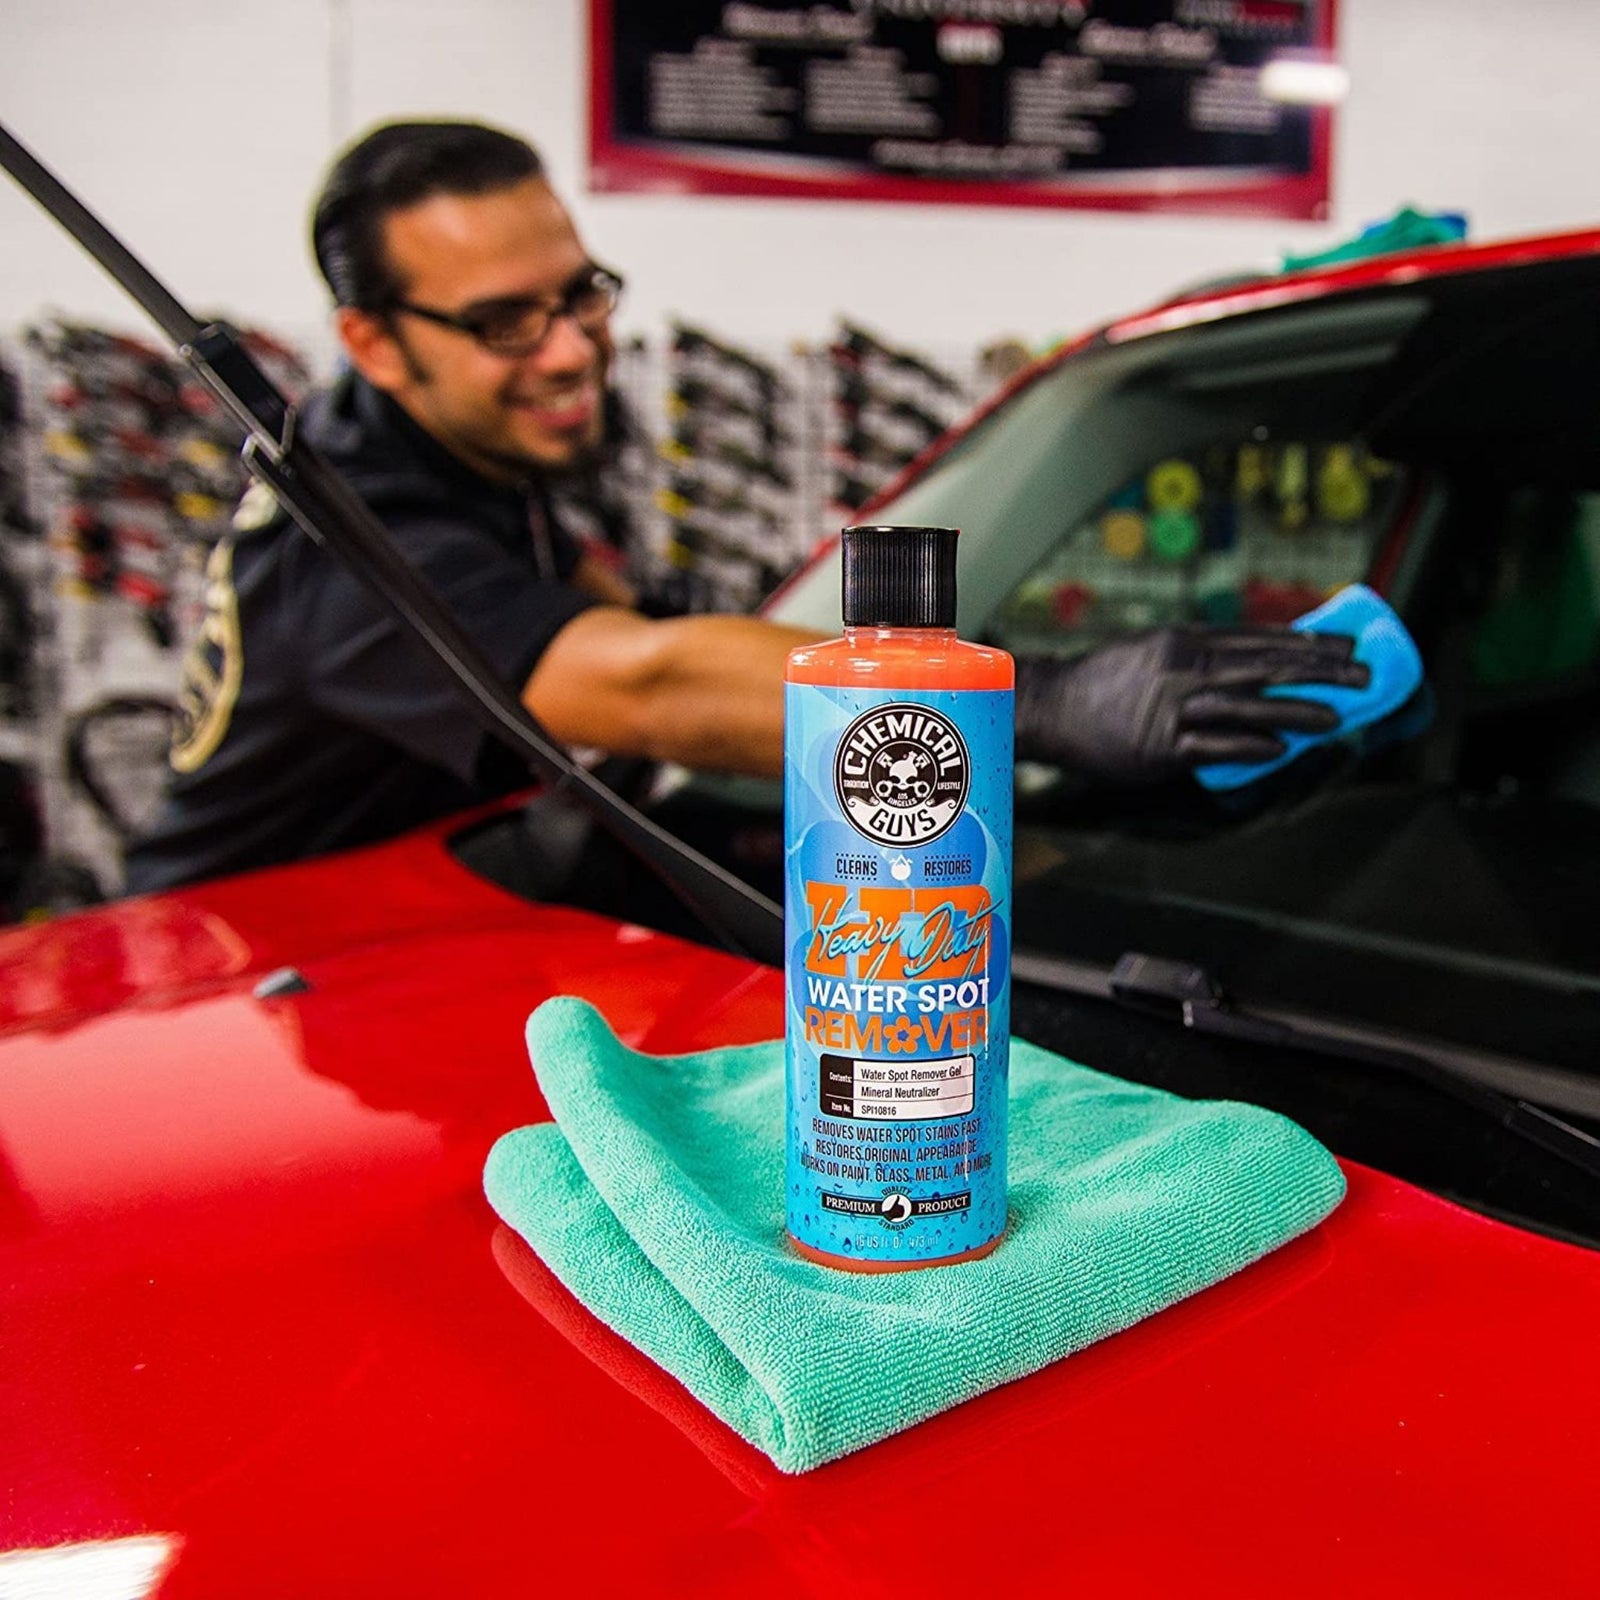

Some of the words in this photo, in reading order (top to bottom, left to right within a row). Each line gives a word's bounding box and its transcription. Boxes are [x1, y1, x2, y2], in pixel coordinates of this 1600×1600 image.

[843, 713, 962, 776] CHEMICAL
[937, 781, 961, 790] LIFESTYLE
[868, 808, 937, 838] GUYS
[836, 858, 878, 876] CLEANS
[924, 859, 972, 877] RESTORES
[803, 894, 906, 995] Heavy
[903, 898, 1004, 985] Duty
[807, 976, 907, 1014] WATER
[917, 977, 990, 1013] SPOT
[861, 1069, 886, 1080] Water
[888, 1069, 908, 1082] Spot
[910, 1069, 947, 1080] Remover
[949, 1065, 962, 1077] Gel
[861, 1086, 893, 1098] Mineral
[895, 1086, 941, 1099] Neutralizer
[861, 1105, 897, 1116] SPI10816
[812, 1117, 854, 1140] REMOVES
[856, 1126, 893, 1143] WATER
[895, 1127, 922, 1143] SPOT
[925, 1123, 960, 1142] STAINS
[961, 1118, 982, 1136] FAST
[815, 1138, 862, 1161] RESTORES
[864, 1147, 913, 1163] ORIGINAL
[801, 1153, 826, 1174] WORKS
[827, 1161, 840, 1177] ON
[954, 1159, 973, 1176] AND
[973, 1151, 993, 1171] MORE
[881, 1186, 913, 1196] QUALITY
[826, 1196, 876, 1214] PREMIUM
[918, 1194, 969, 1214] PRODUCT
[878, 1218, 915, 1232] STANDARD
[855, 1234, 865, 1247] 16
[866, 1235, 879, 1248] US
